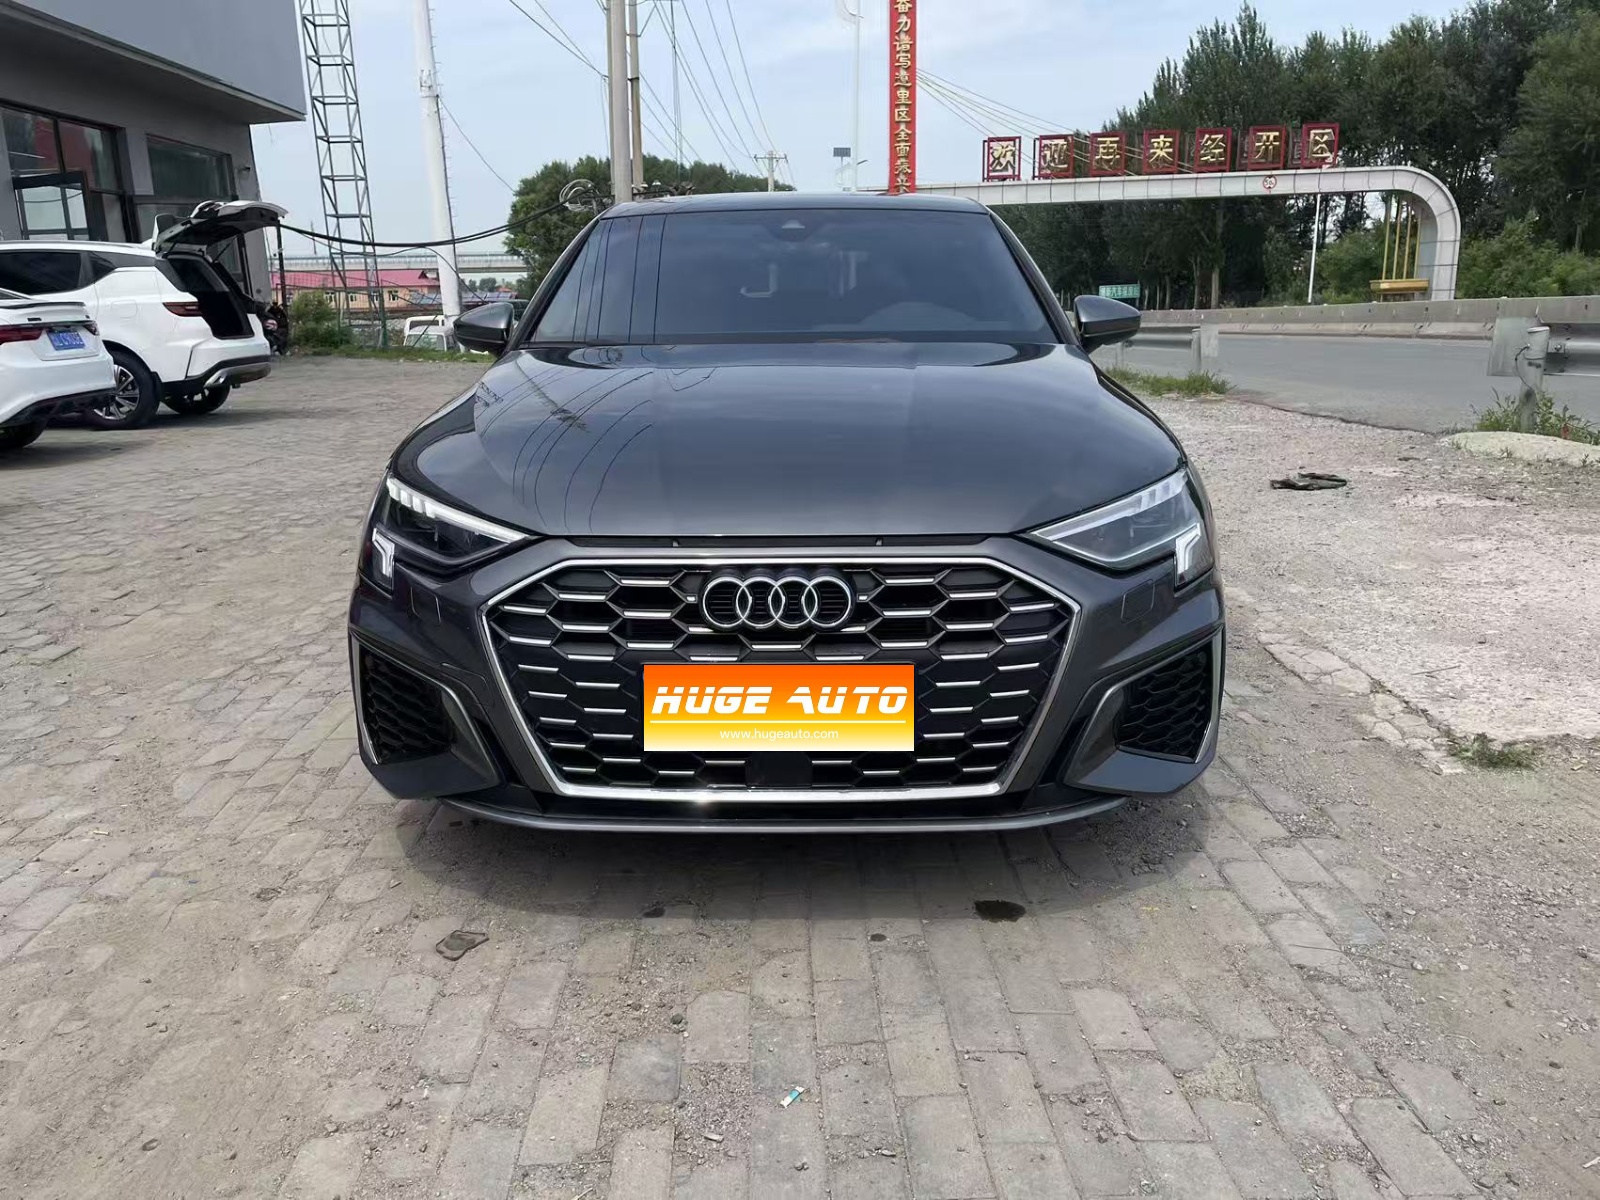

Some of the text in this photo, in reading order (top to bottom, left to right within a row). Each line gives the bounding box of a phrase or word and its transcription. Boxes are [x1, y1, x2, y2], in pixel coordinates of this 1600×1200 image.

[989, 128, 1335, 172] 欢迎再来经开区
